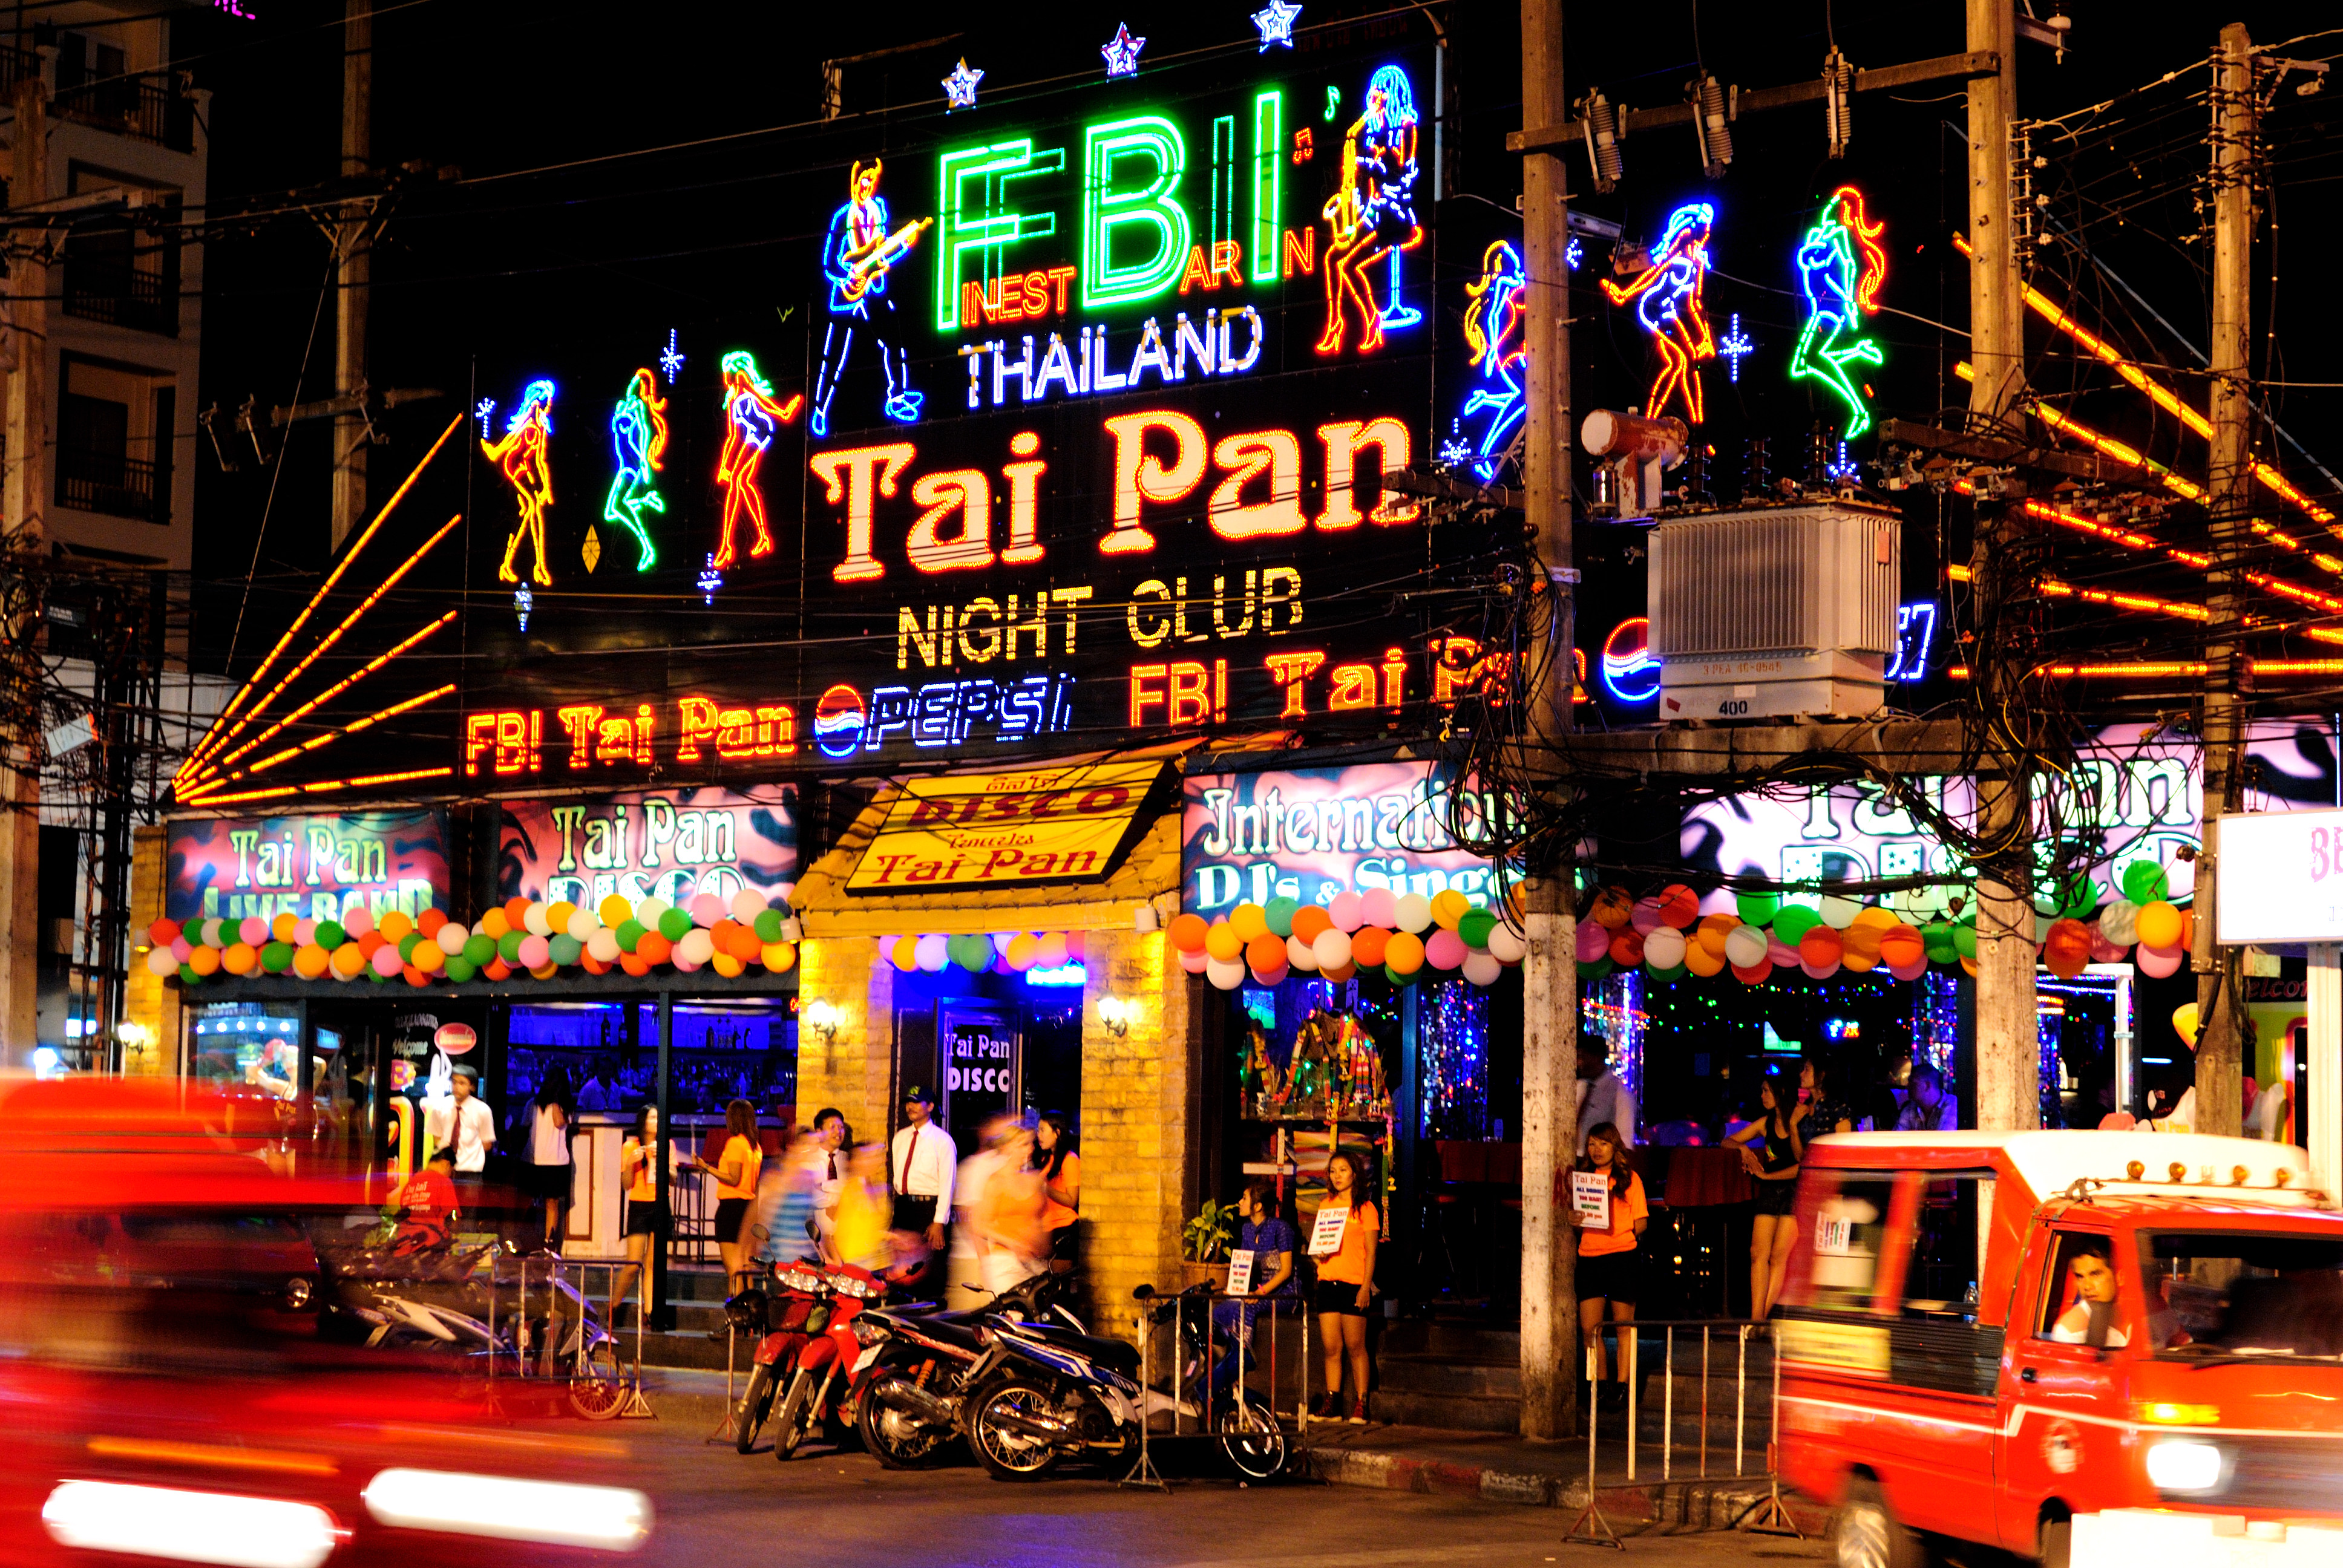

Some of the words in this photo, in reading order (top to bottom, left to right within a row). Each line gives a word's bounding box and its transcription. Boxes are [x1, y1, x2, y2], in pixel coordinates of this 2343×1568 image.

[958, 304, 1263, 409] THAILAND
[810, 430, 1046, 583] Tai
[1098, 409, 1421, 555] Pan
[896, 584, 1093, 669] NIGHT
[1126, 566, 1302, 648] CLUB
[865, 673, 1075, 751] PEPSI
[1265, 647, 1406, 720] Tai
[1719, 700, 1748, 716] 400
[558, 704, 654, 768] Tai
[677, 697, 798, 761] Pan
[551, 804, 629, 871] Tai
[641, 798, 737, 867] Pan
[907, 786, 1130, 827] DISCO
[229, 830, 294, 887] Tai
[305, 826, 387, 886] Pan
[872, 853, 966, 884] Tai
[974, 849, 1098, 879] Pan
[1315, 880, 1342, 906] &
[945, 1032, 973, 1058] Tai
[977, 1033, 1010, 1059] Pan
[947, 1067, 1010, 1093] DISCO
[1590, 1175, 1607, 1186] Pan
